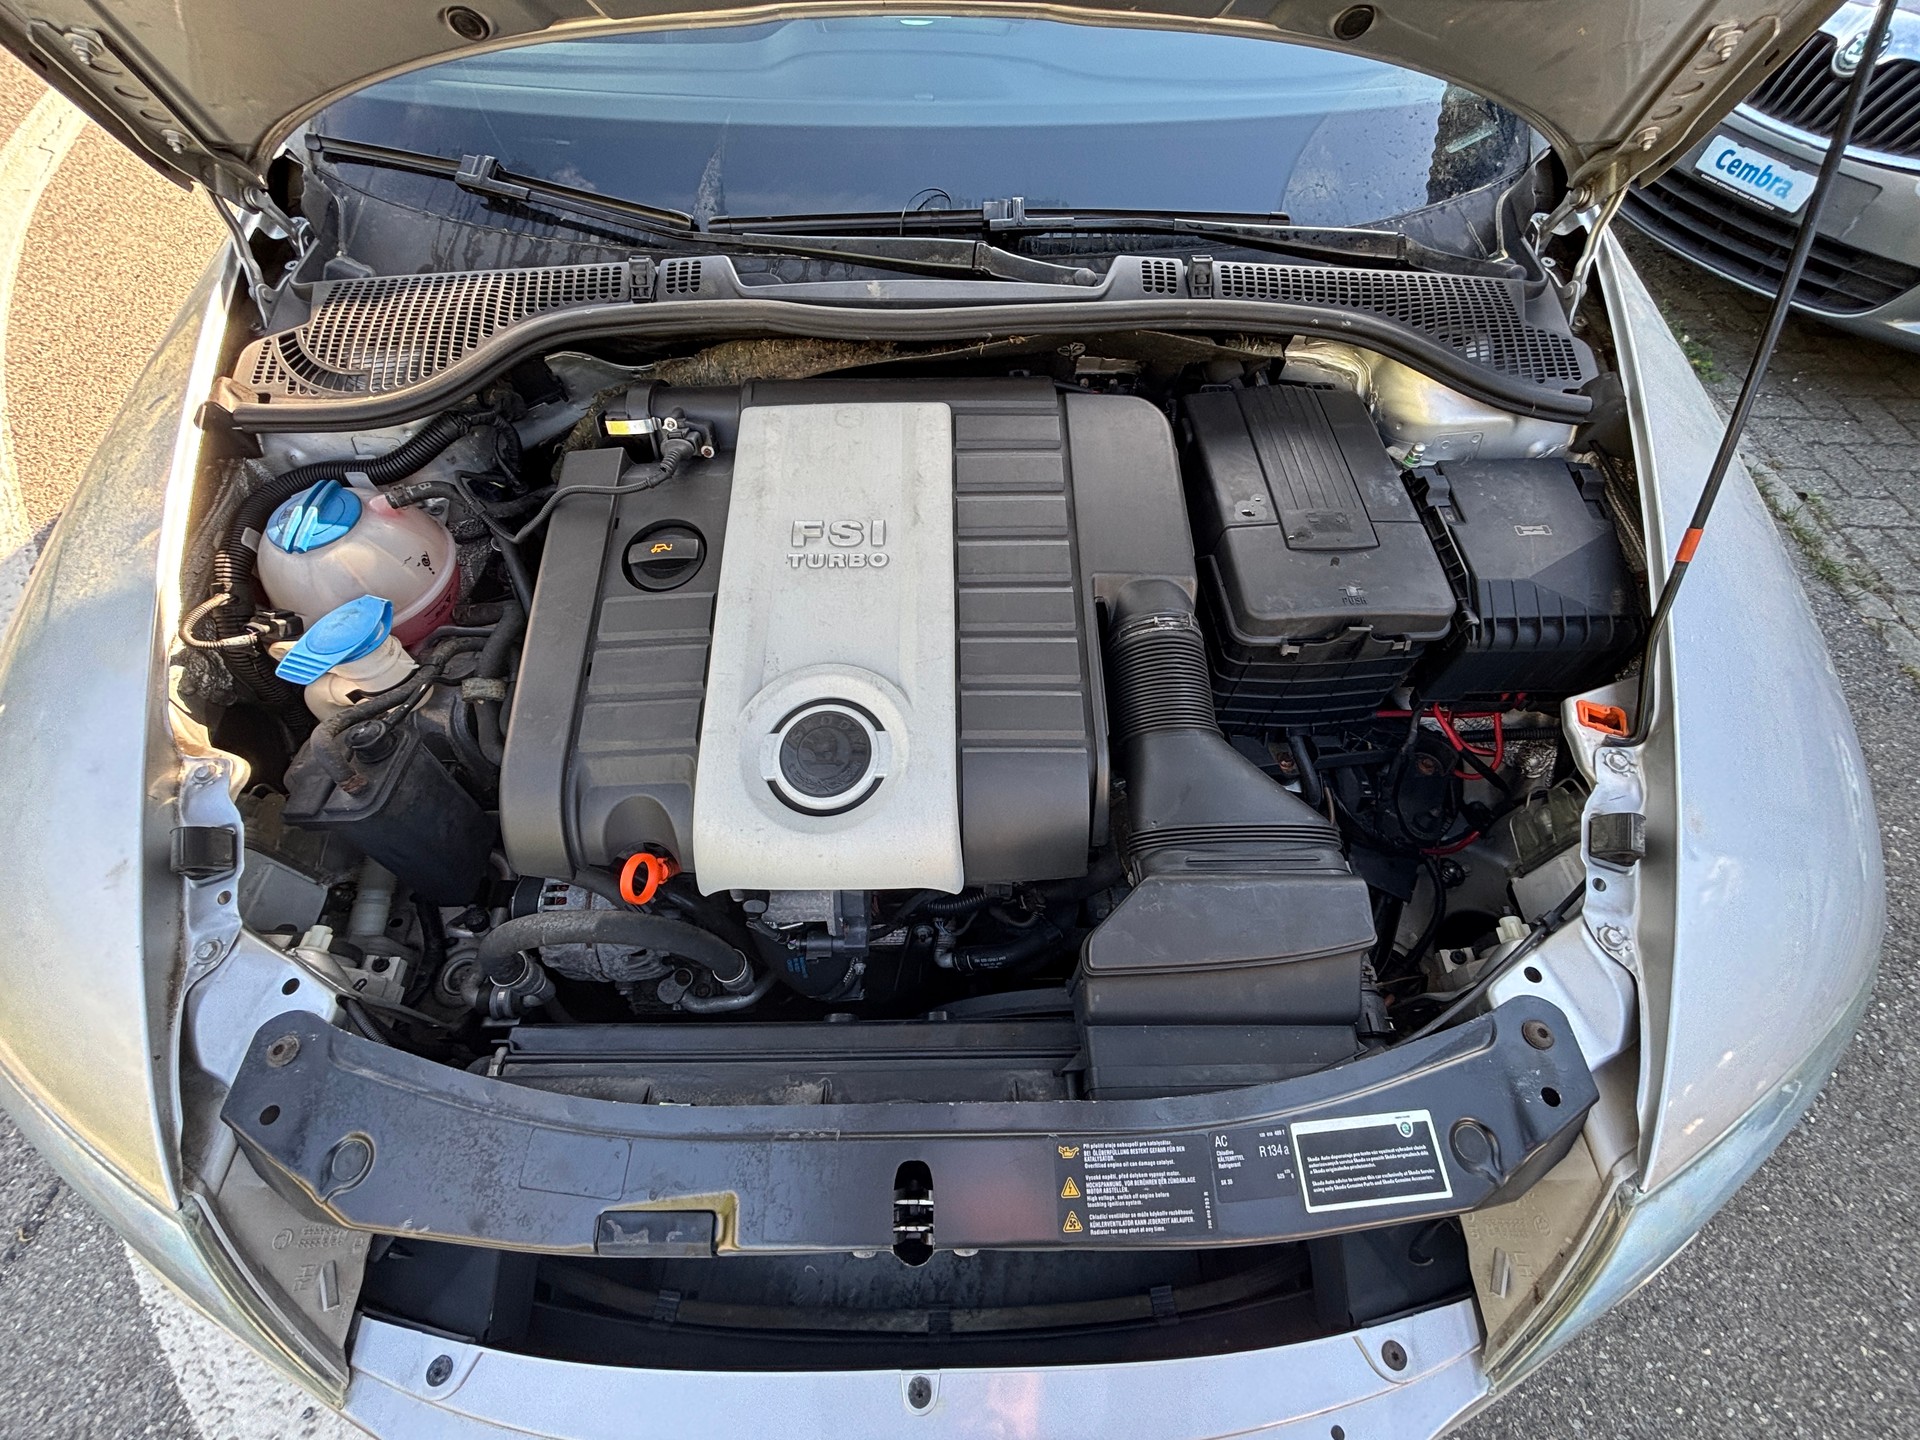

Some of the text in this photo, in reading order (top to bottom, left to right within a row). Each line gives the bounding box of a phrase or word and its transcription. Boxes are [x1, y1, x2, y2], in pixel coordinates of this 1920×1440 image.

[1715, 149, 1793, 199] Cembra
[791, 519, 886, 547] FSI
[787, 552, 889, 568] TURBO
[1215, 1135, 1228, 1148] AC
[1259, 1146, 1267, 1157] R
[1267, 1144, 1283, 1156] 134
